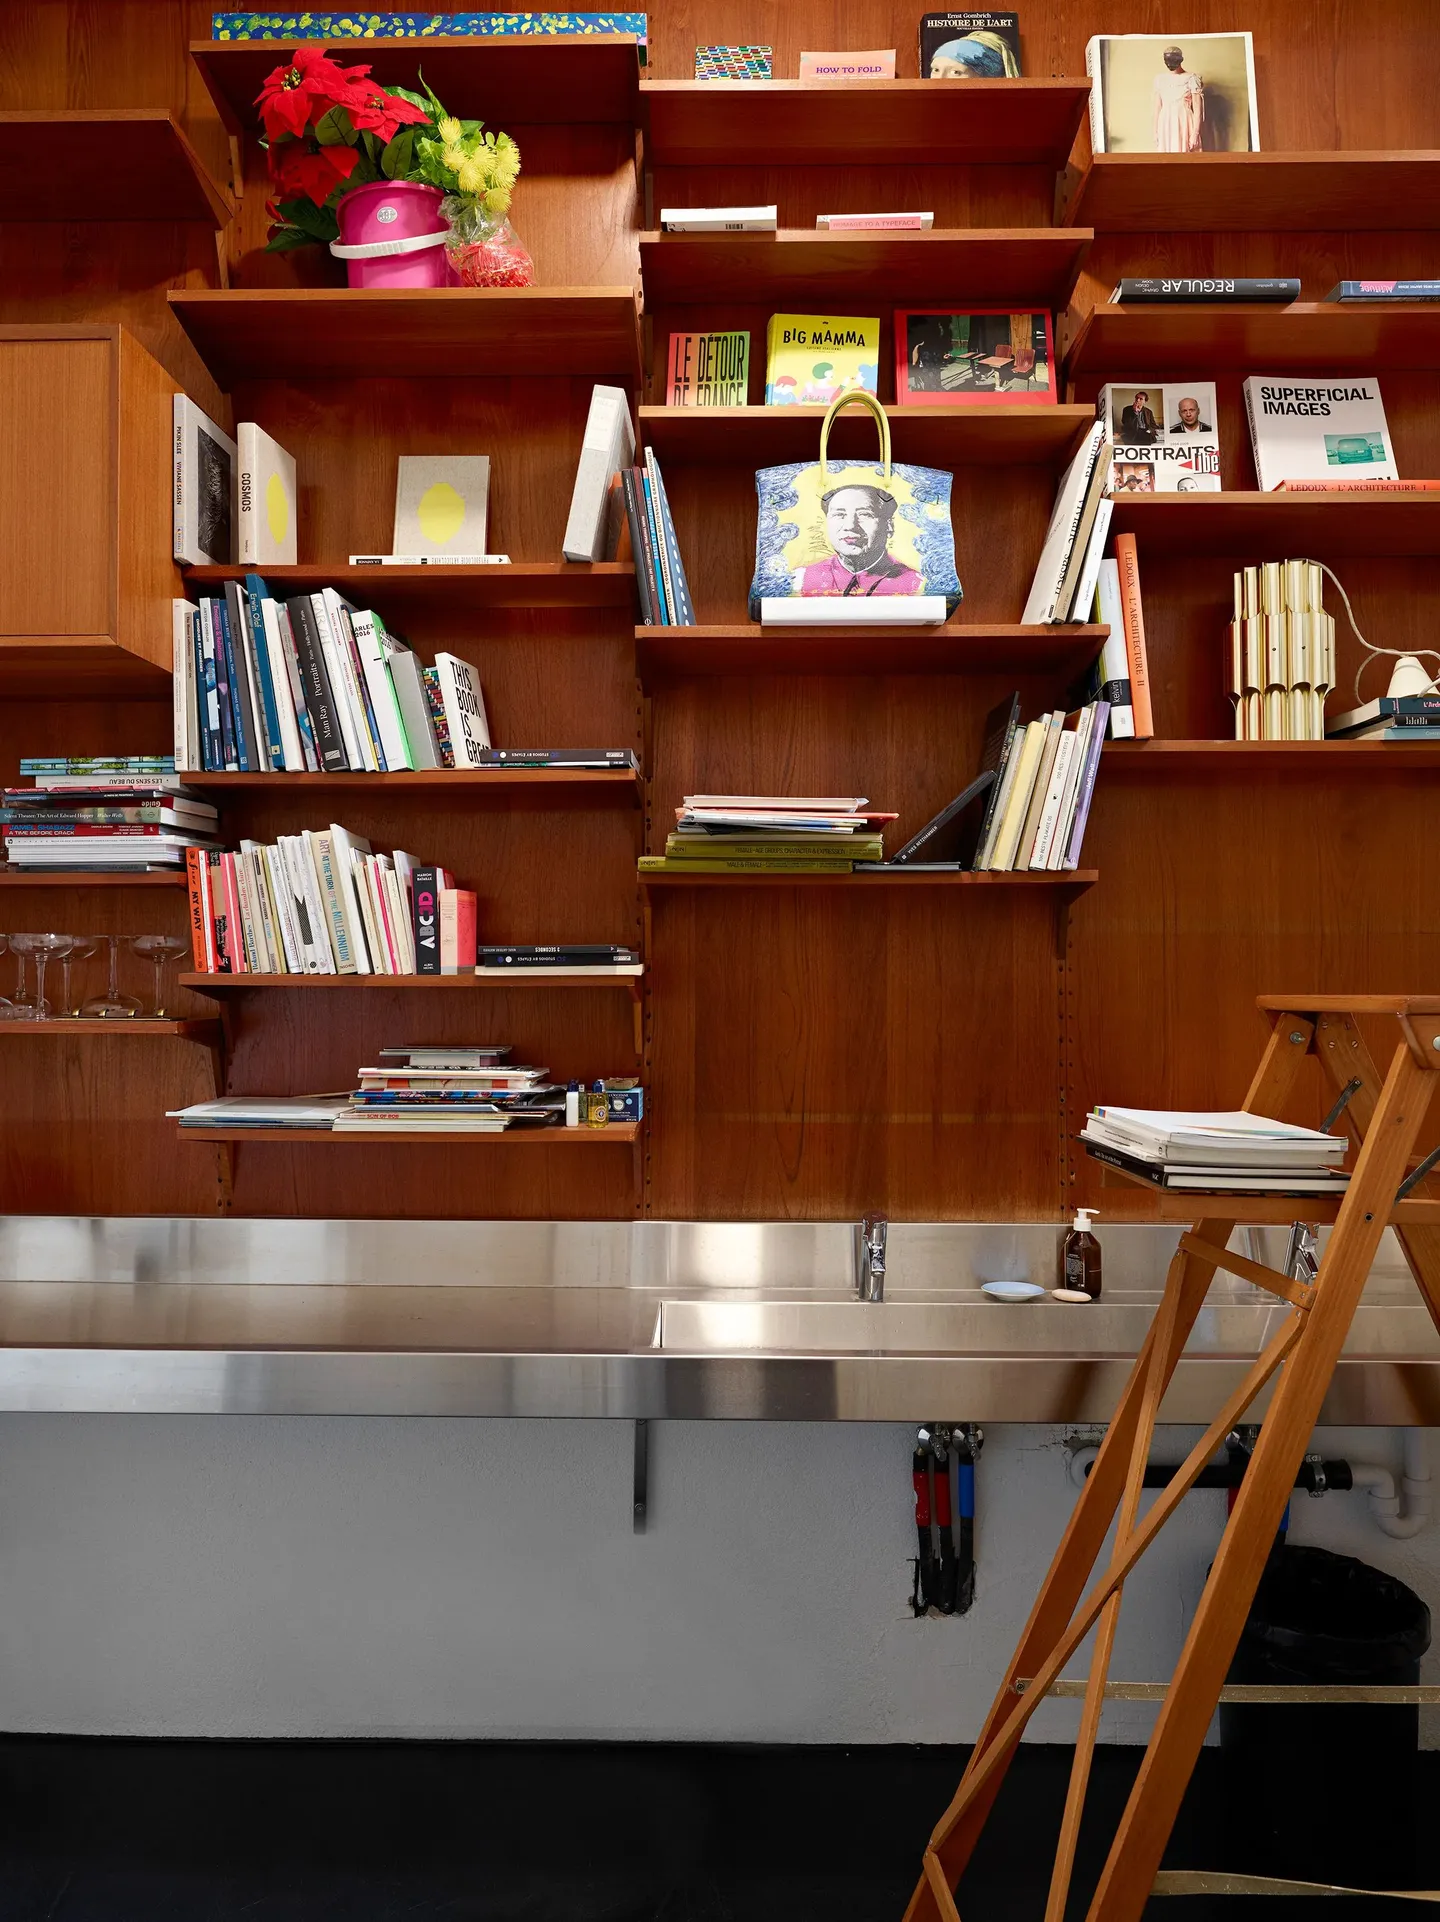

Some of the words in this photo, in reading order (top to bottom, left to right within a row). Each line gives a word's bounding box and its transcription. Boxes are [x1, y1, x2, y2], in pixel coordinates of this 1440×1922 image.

[1161, 280, 1234, 292] REGULAR
[783, 328, 806, 344] BIG
[812, 330, 865, 347] MAMMA
[675, 337, 691, 382] LE
[698, 334, 745, 382] DÉTOUR
[1260, 386, 1373, 401] SUPERFICIAL
[1263, 401, 1331, 416] IMAGES
[1113, 445, 1216, 460] PORTRAITS
[241, 473, 251, 512] COSMOS
[250, 593, 259, 612] Erwin
[252, 613, 262, 628] Olaf
[355, 624, 374, 632] ARLES
[1124, 551, 1137, 588] LEDOUX
[1137, 678, 1145, 687] II
[309, 663, 322, 696] Portraits
[450, 661, 472, 691] THIS
[1112, 680, 1120, 703] kelvin
[320, 704, 330, 719] Ray
[456, 687, 481, 718] BOOK
[323, 718, 333, 738] Man
[460, 713, 472, 738] IS
[318, 838, 330, 855] ART
[325, 874, 334, 890] TURN
[191, 891, 198, 904] MY
[240, 885, 248, 910] chambre
[328, 890, 336, 899] OF
[330, 899, 338, 911] THE
[243, 910, 250, 920] La
[245, 924, 254, 947] Barthes
[332, 911, 350, 962] MILLENNIUM
[249, 948, 258, 969] Roland
